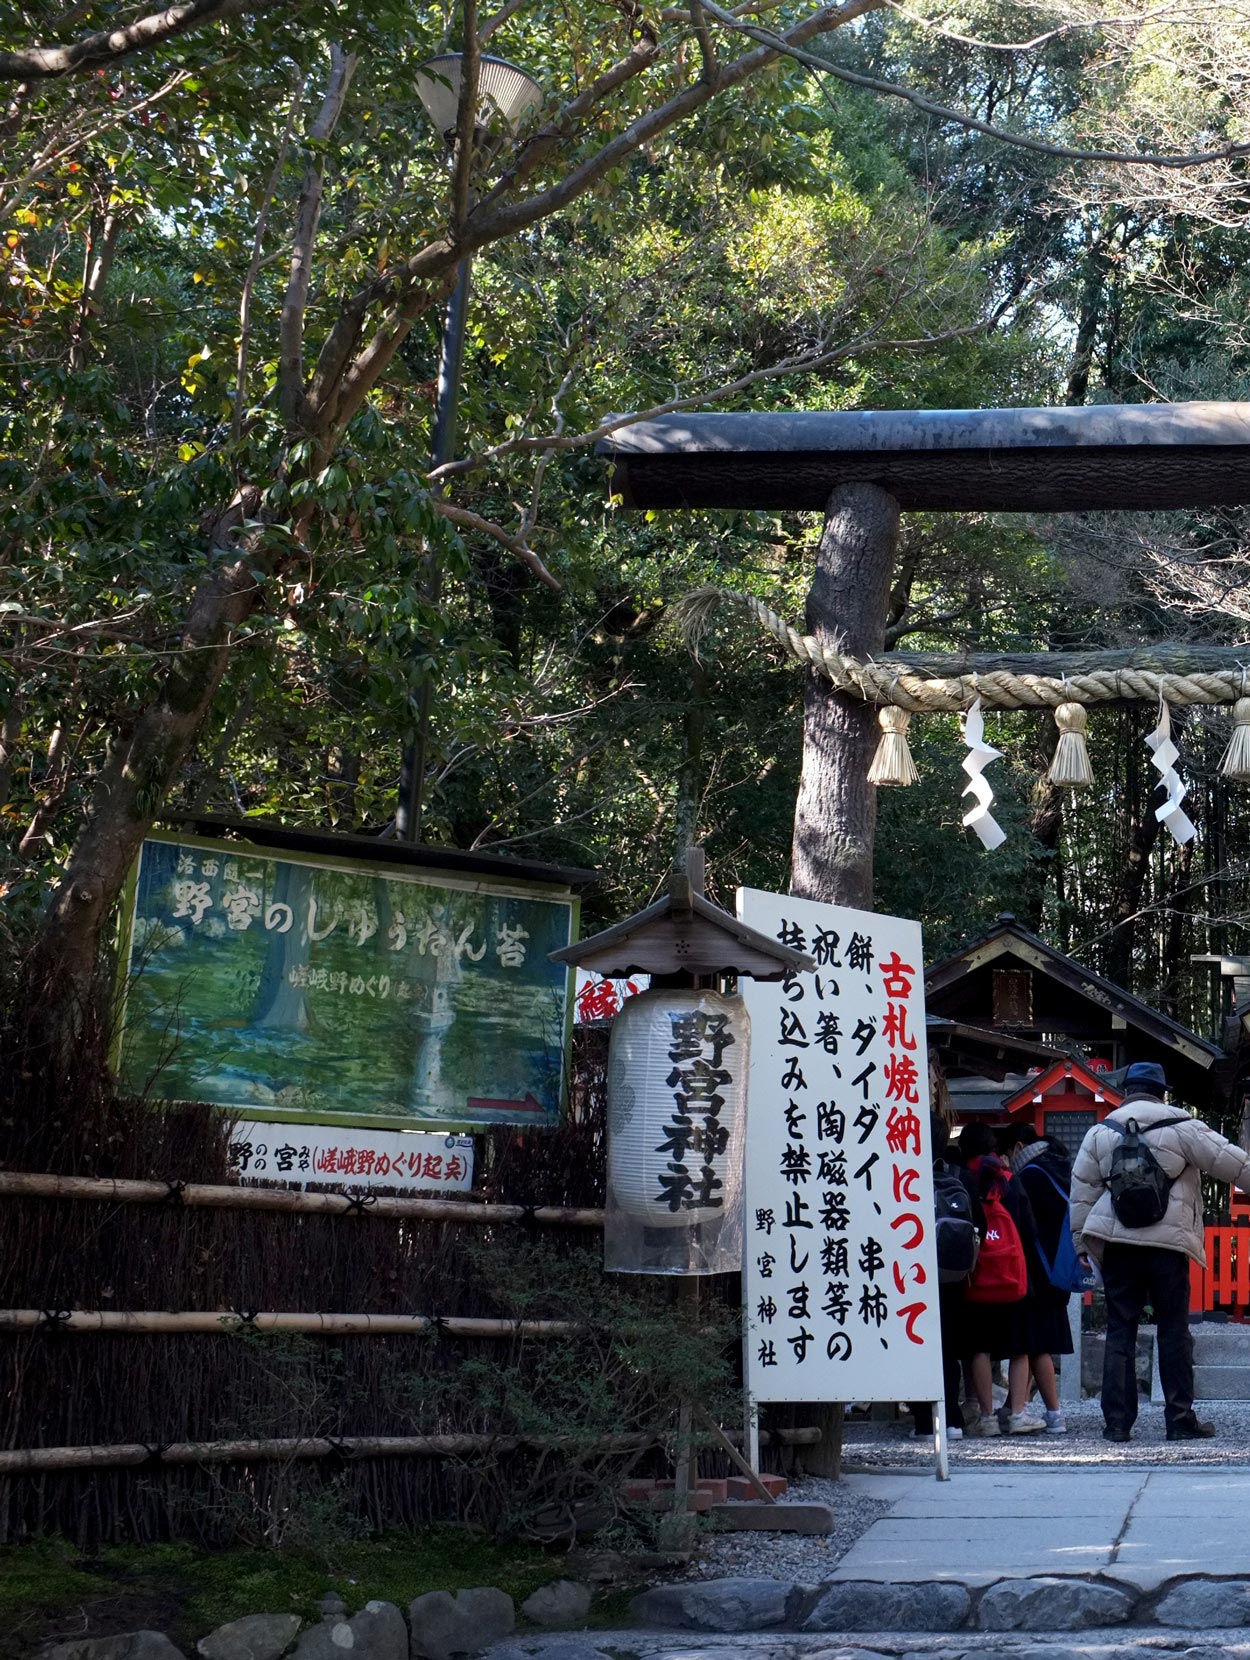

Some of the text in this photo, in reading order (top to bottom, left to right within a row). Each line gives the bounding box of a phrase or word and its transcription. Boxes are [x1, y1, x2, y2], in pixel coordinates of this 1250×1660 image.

[654, 1009, 735, 1213] 野宮神社
[878, 951, 928, 1346] 古札焼納について
[755, 1208, 779, 1367] 野宮神社
